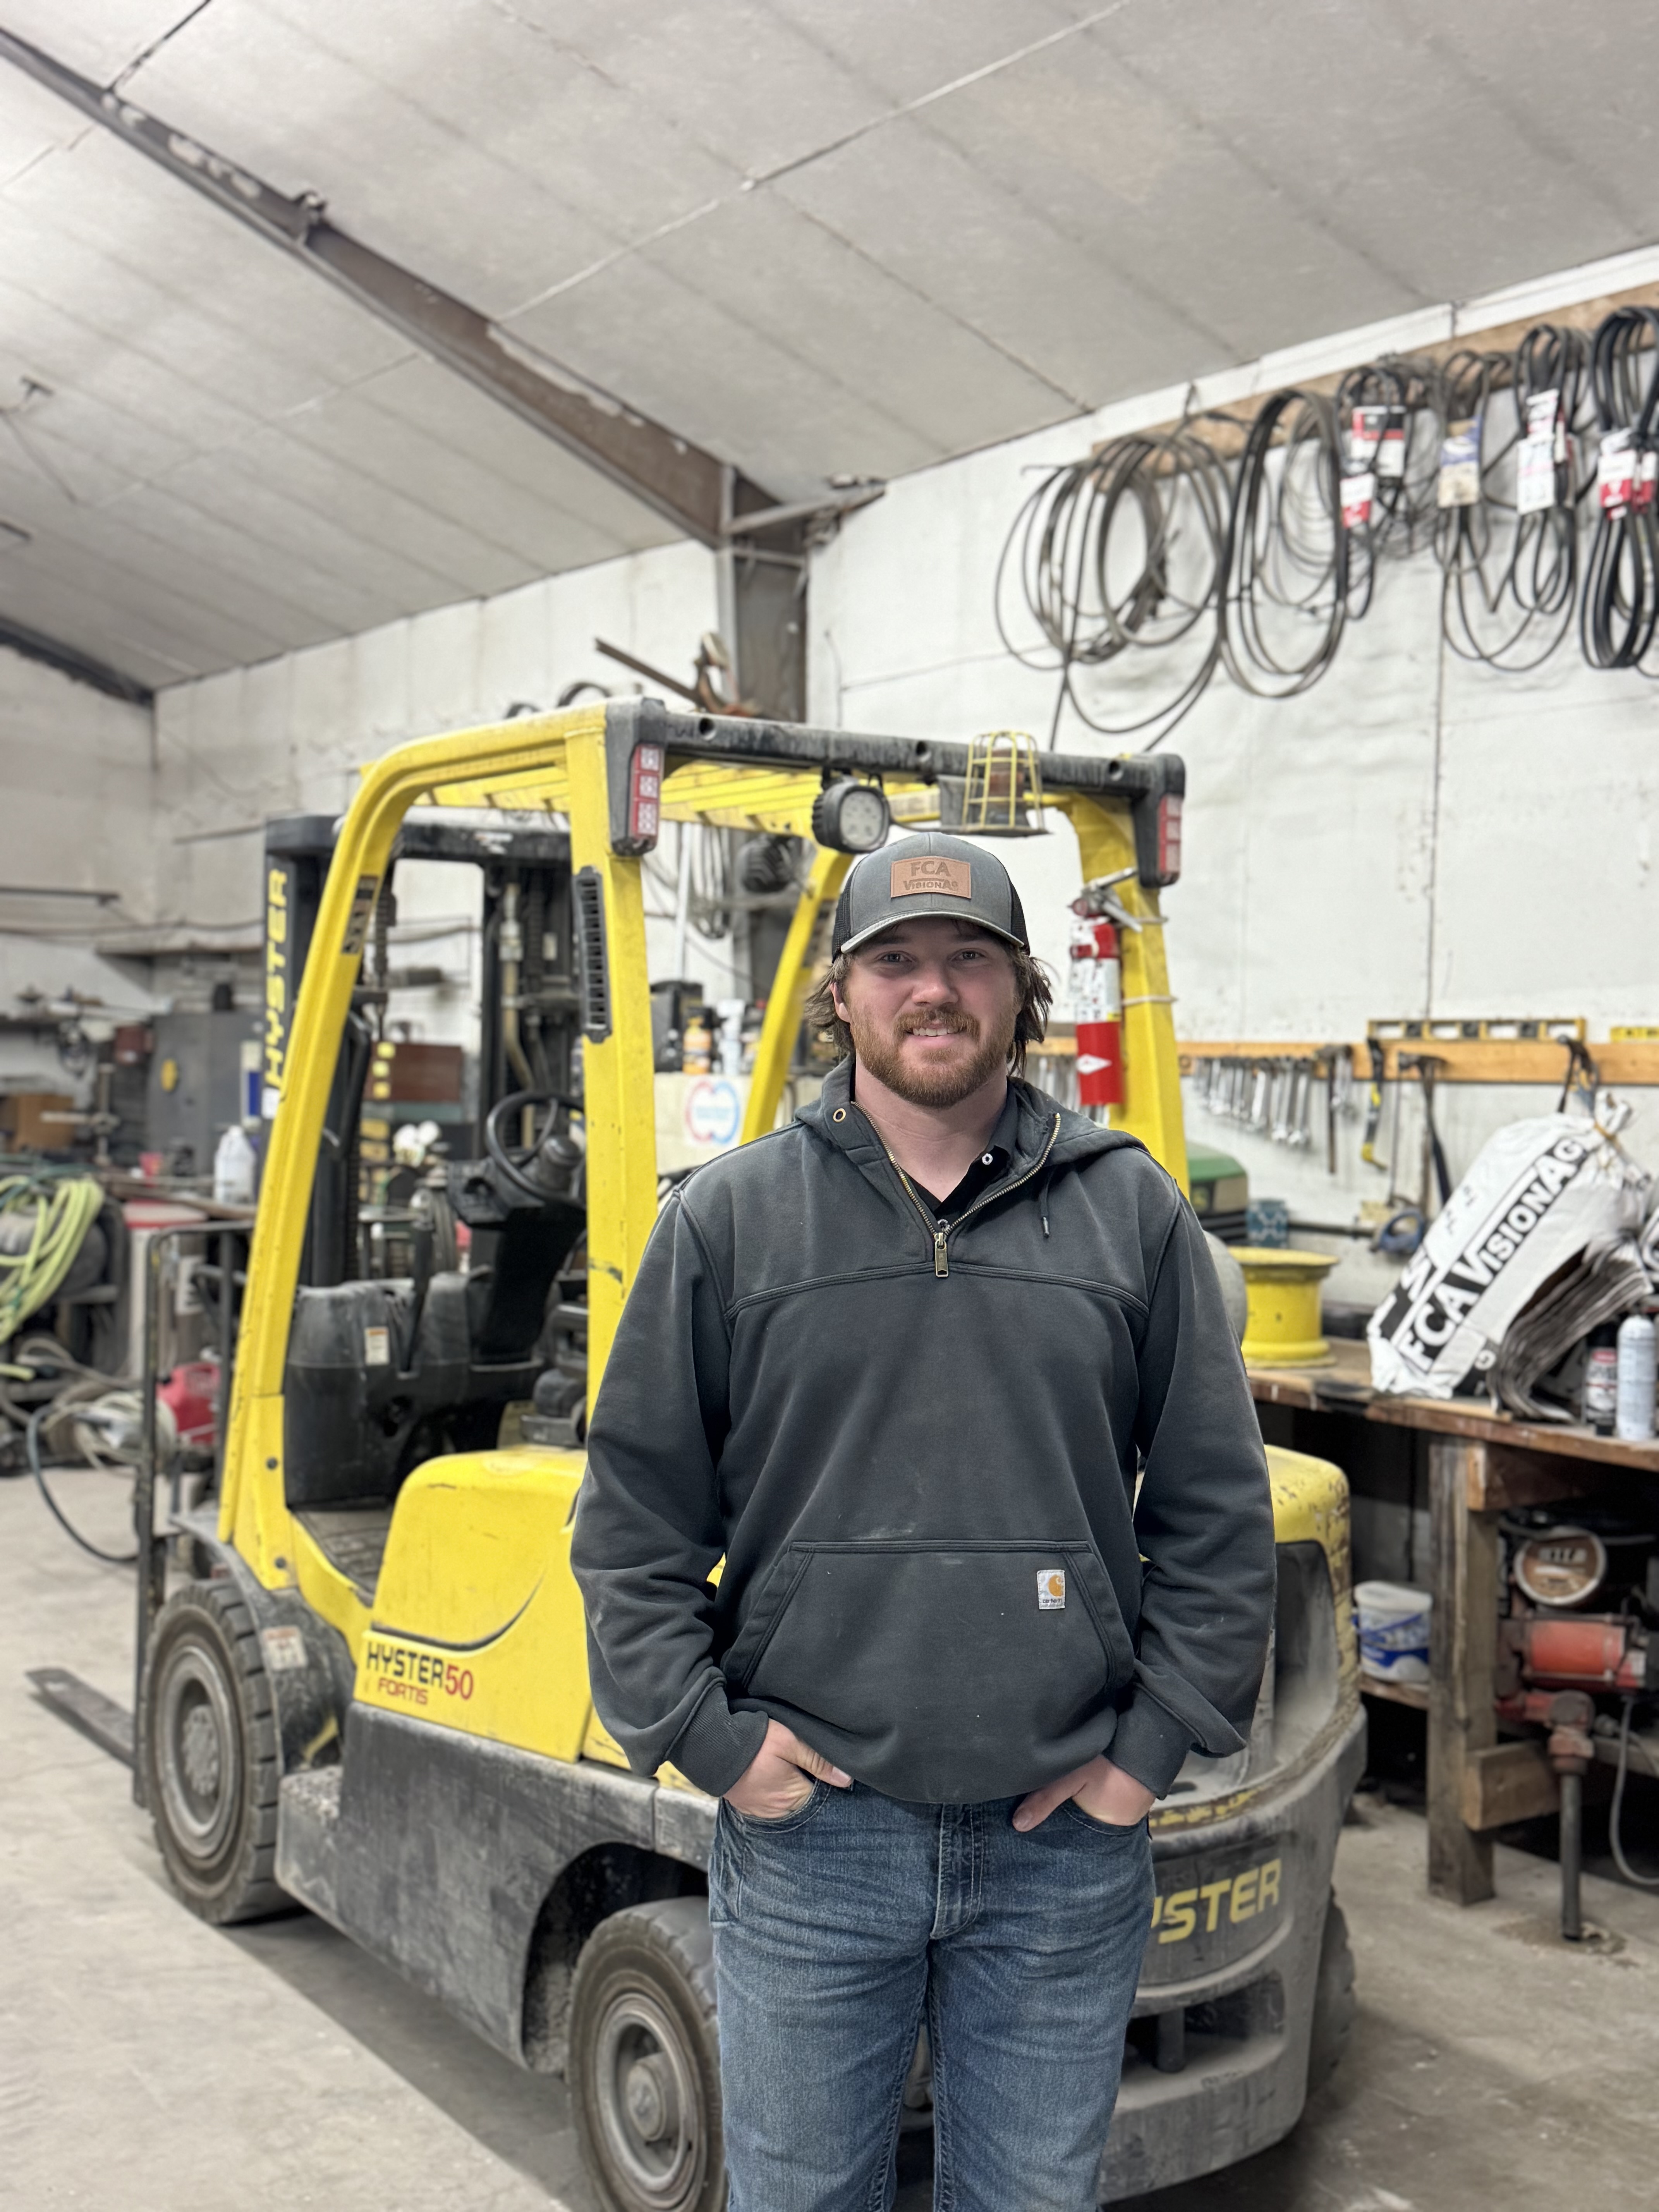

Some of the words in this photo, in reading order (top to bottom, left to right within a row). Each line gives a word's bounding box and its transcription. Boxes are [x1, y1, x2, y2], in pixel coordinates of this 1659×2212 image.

[911, 861, 951, 877] FCA
[265, 869, 286, 1087] HYSTER
[1397, 1283, 1480, 1372] FCA
[366, 1641, 444, 1688] HYSTER
[445, 1664, 474, 1700] 50
[378, 1678, 429, 1705] FORTIS
